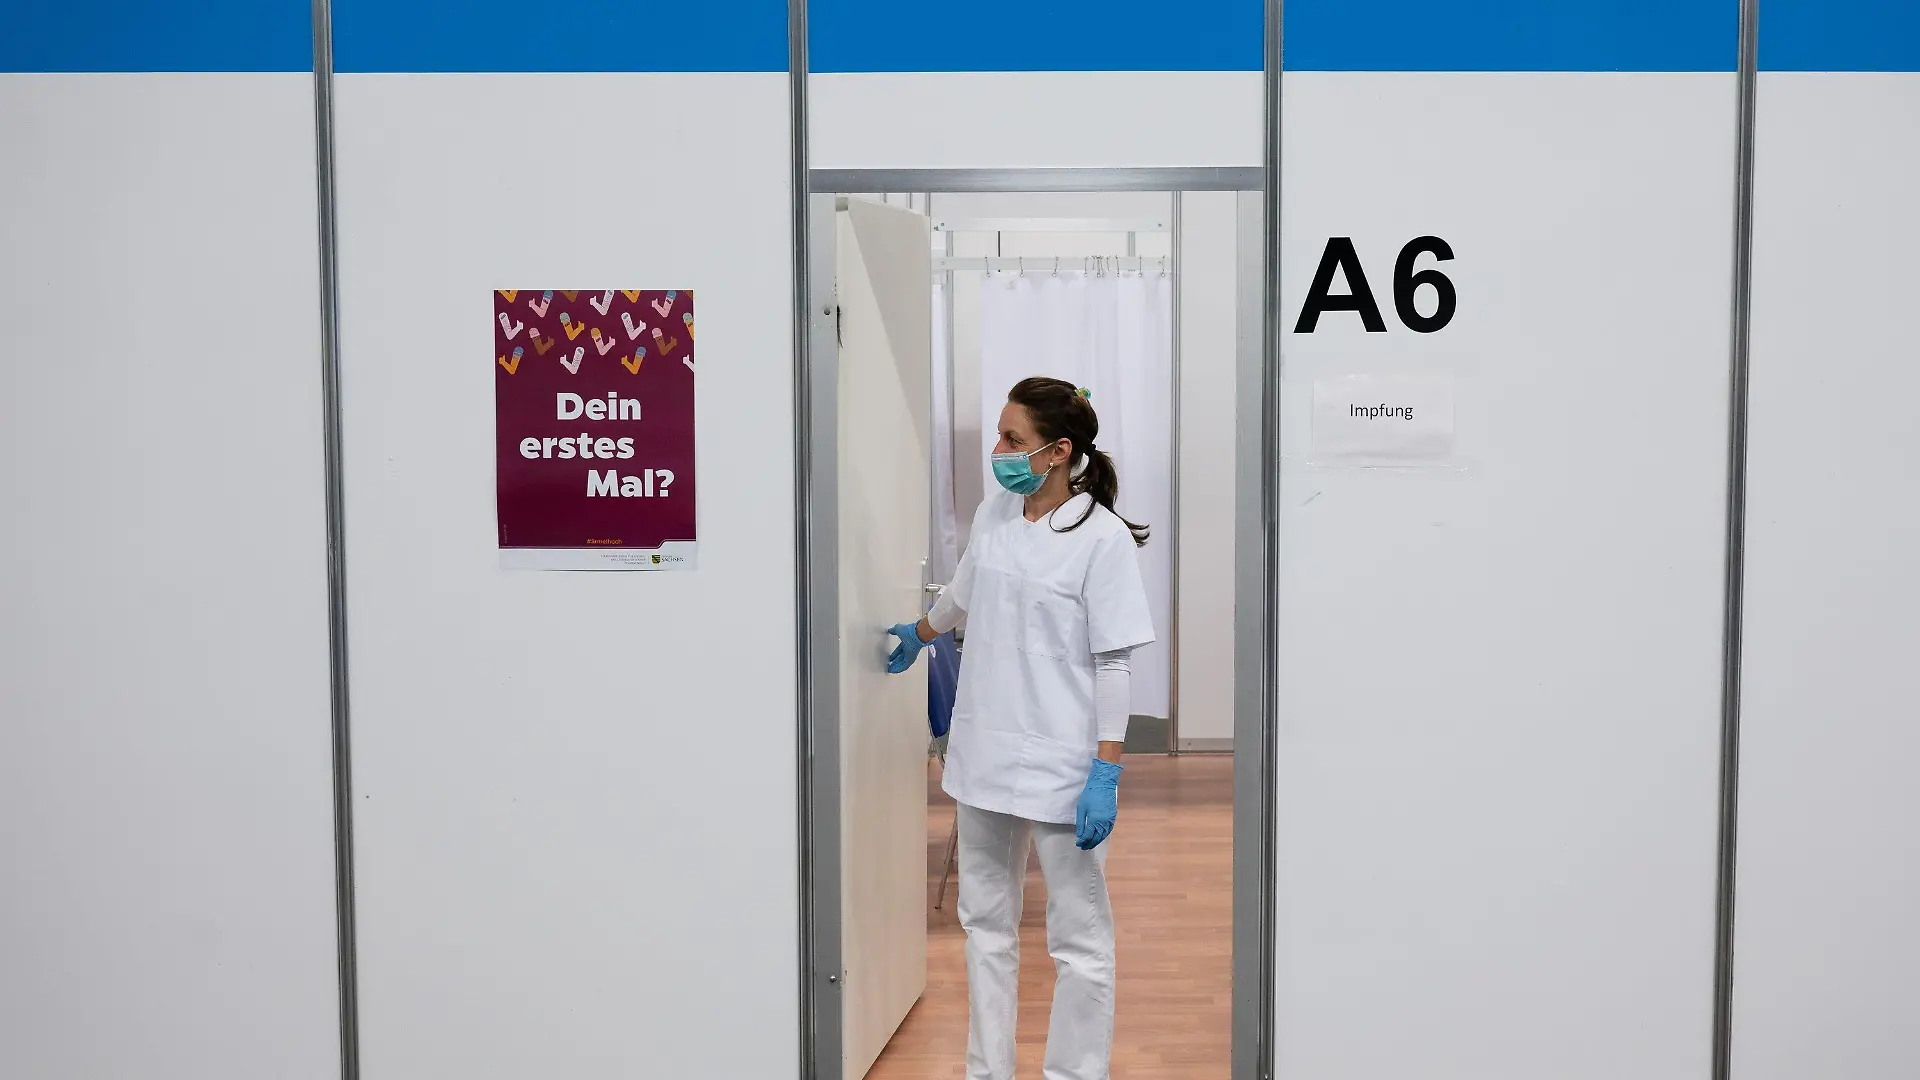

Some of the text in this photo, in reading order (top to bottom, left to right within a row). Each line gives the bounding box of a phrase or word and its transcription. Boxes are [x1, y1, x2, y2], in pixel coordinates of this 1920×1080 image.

[1294, 236, 1457, 333] A6
[556, 391, 642, 421] Dein
[1350, 403, 1414, 420] Impfung
[519, 432, 635, 459] erstes
[586, 468, 675, 498] Mal?
